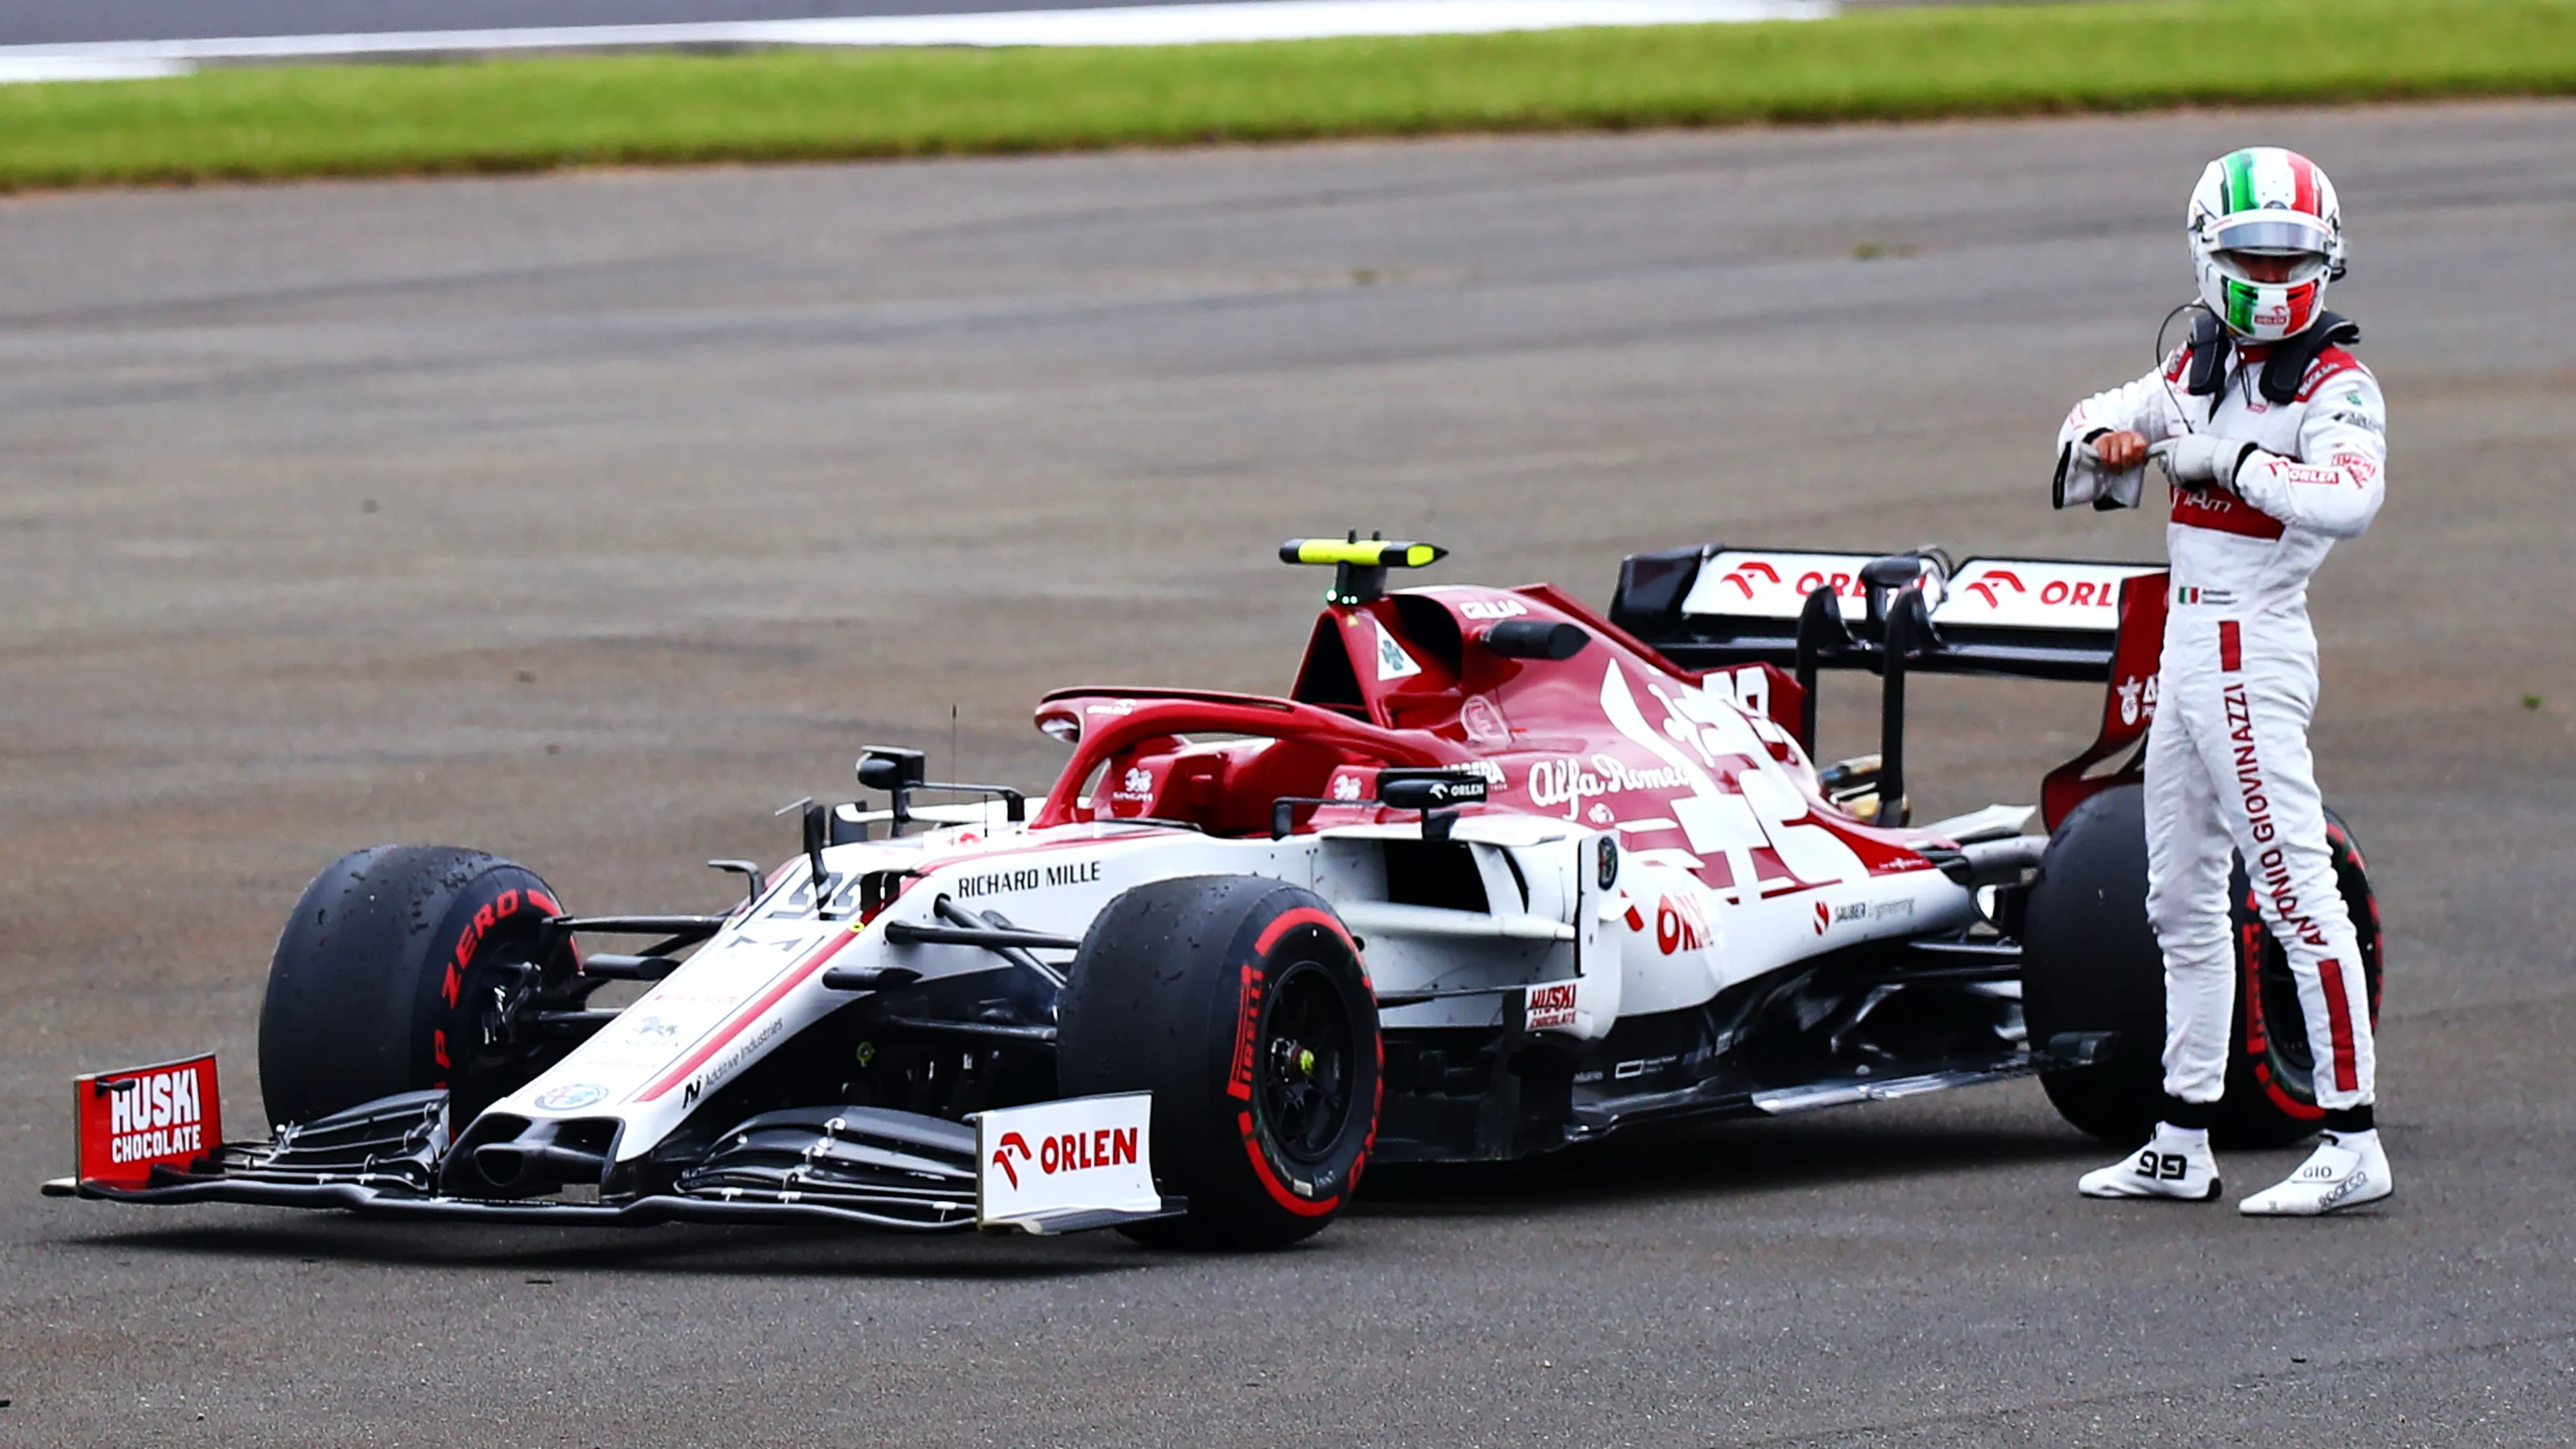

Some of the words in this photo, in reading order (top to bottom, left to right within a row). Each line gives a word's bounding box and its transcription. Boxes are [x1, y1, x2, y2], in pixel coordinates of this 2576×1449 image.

[2222, 683, 2275, 843] GIOVINAZZI
[1450, 783, 1484, 797] ORLEN
[1528, 757, 1606, 821] Alfa
[1590, 753, 1691, 793] Romeo
[957, 868, 1039, 899] RICHARD
[1044, 861, 1102, 887] MILLE
[2260, 848, 2329, 946] ANTONIO
[442, 889, 519, 1009] ZERO
[434, 1030, 451, 1069] P
[110, 1067, 202, 1135] HUSKI
[111, 1124, 202, 1163] CHOCOLATE
[1040, 1128, 1138, 1174] ORLEN
[2136, 1150, 2188, 1181] 99
